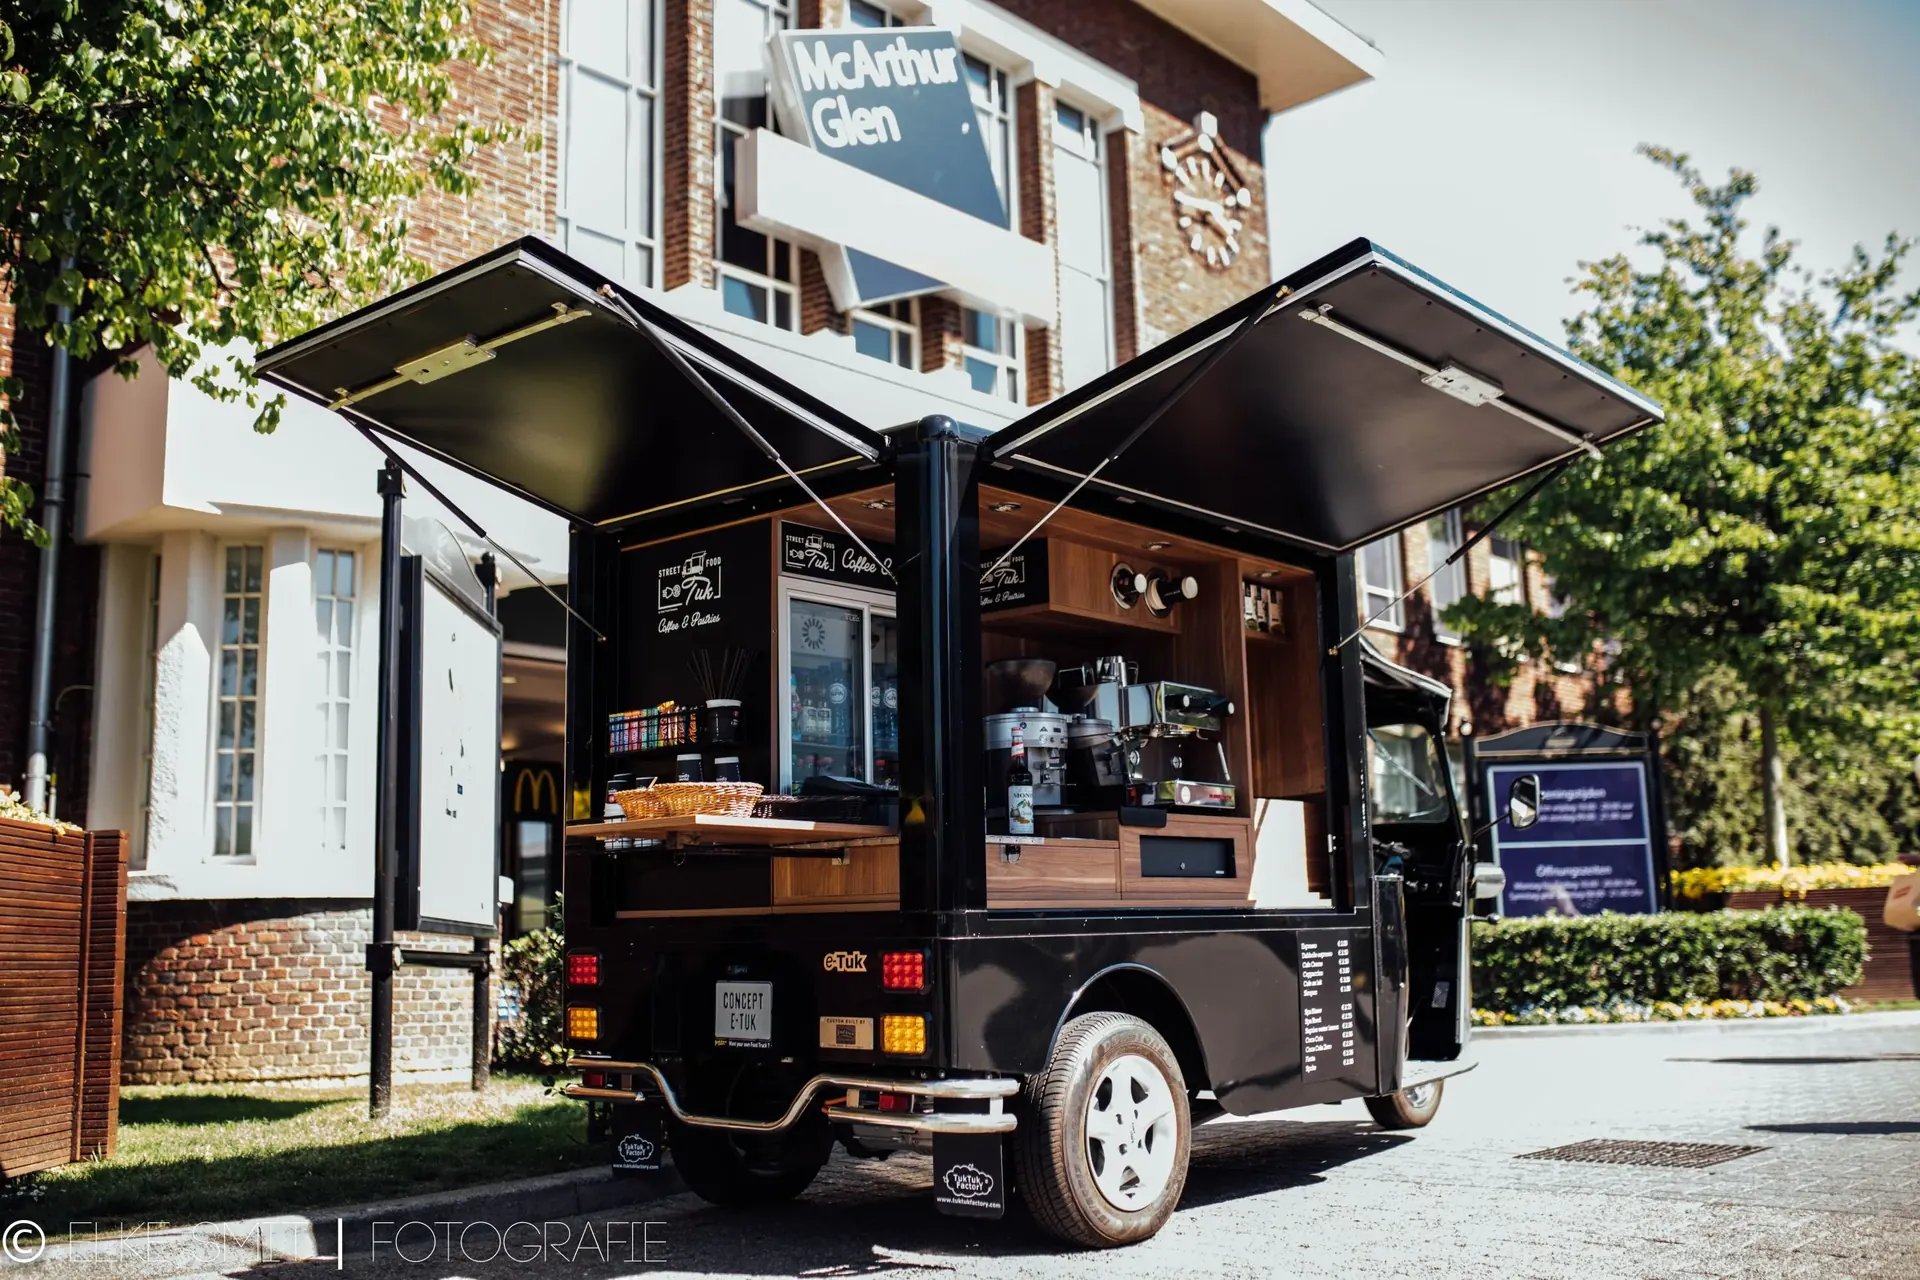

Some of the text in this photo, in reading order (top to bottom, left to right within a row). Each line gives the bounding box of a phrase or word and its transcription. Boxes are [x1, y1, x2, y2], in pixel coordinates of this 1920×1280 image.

[793, 36, 959, 91] McArthur
[811, 95, 901, 148] Glen
[785, 534, 835, 550] STREET FOOD
[658, 556, 722, 578] STREET FOOD
[804, 548, 830, 570] Tuk
[842, 548, 877, 573] Coffee
[993, 568, 1020, 588] Tuk
[681, 576, 714, 606] Tuk
[658, 611, 721, 634] Coffee & Pastries
[824, 951, 867, 972] e-Tuk
[723, 991, 764, 1010] CONCEPT
[730, 1013, 757, 1031] E-TUK
[953, 1173, 981, 1184] TukTuk
[936, 1197, 1002, 1209] www.tuktukfactory.com
